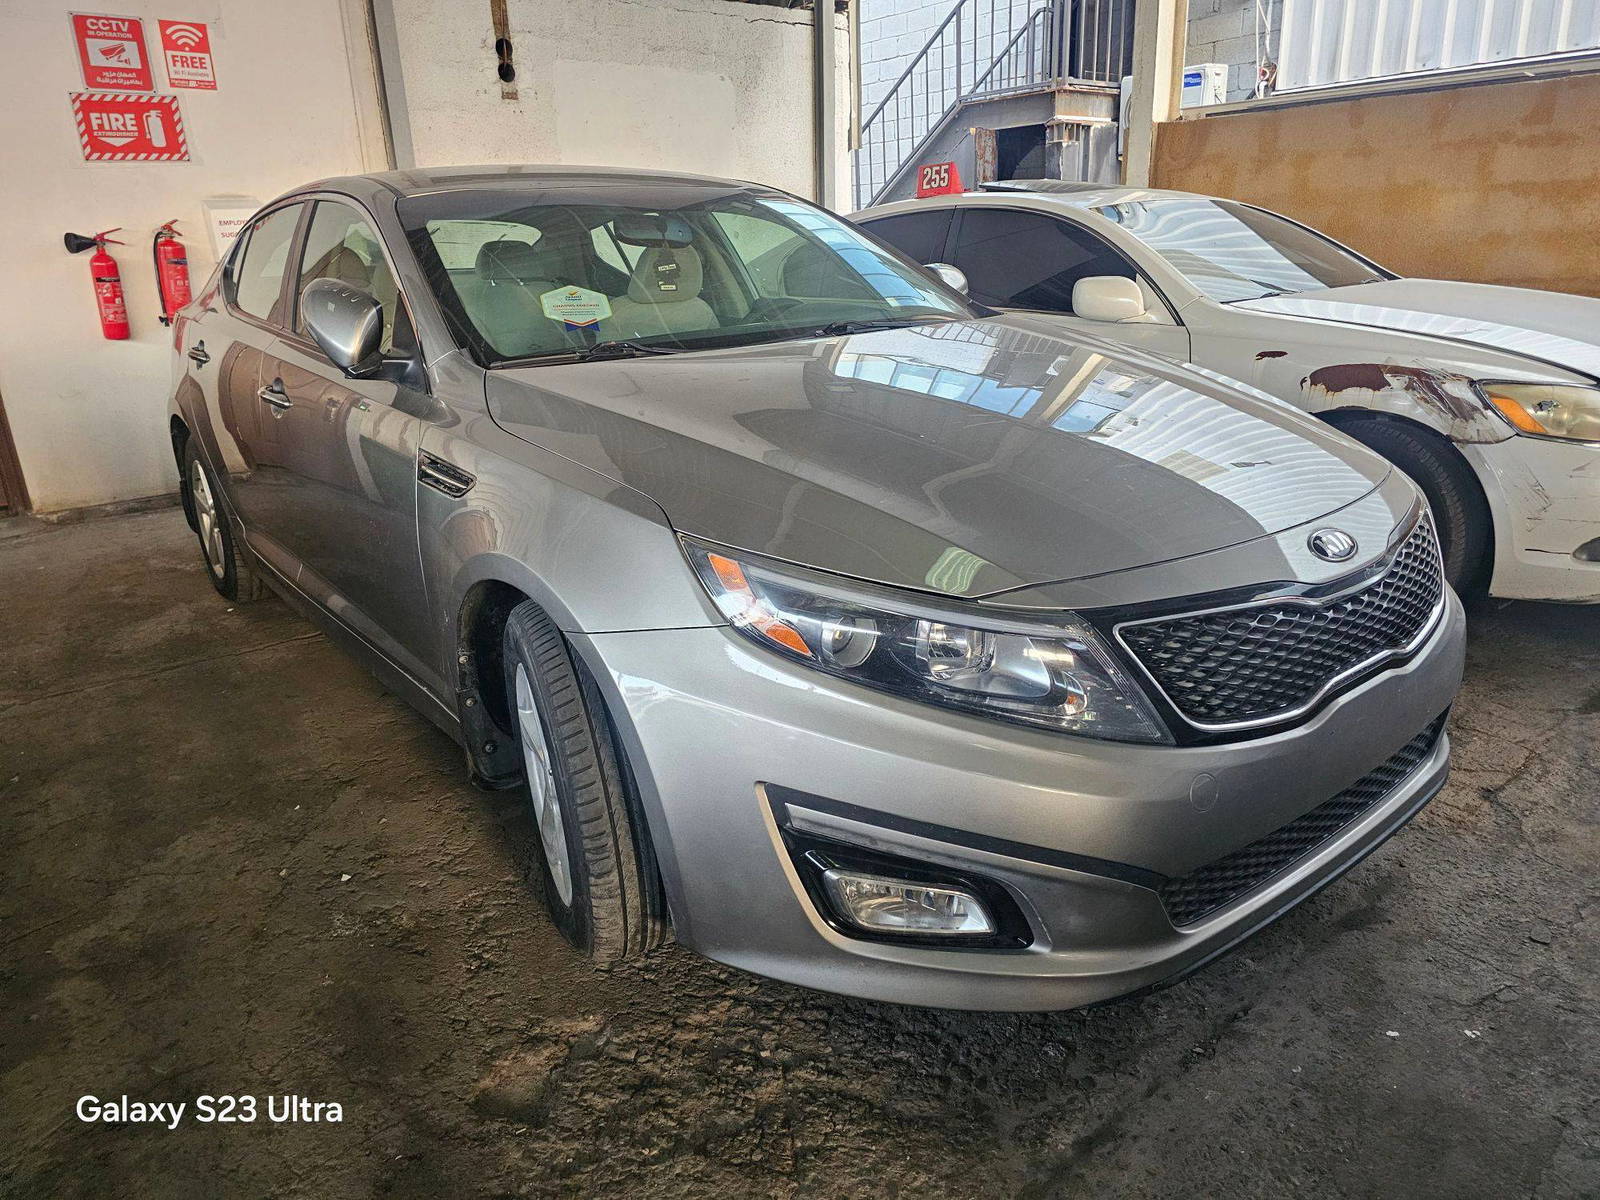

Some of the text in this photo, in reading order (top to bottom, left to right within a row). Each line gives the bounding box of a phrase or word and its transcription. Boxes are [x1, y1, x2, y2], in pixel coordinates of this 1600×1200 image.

[86, 18, 129, 32] CCTV
[96, 31, 133, 39] OPERATION
[171, 54, 208, 70] FREE
[89, 112, 139, 131] FIRE
[922, 164, 950, 190] 255
